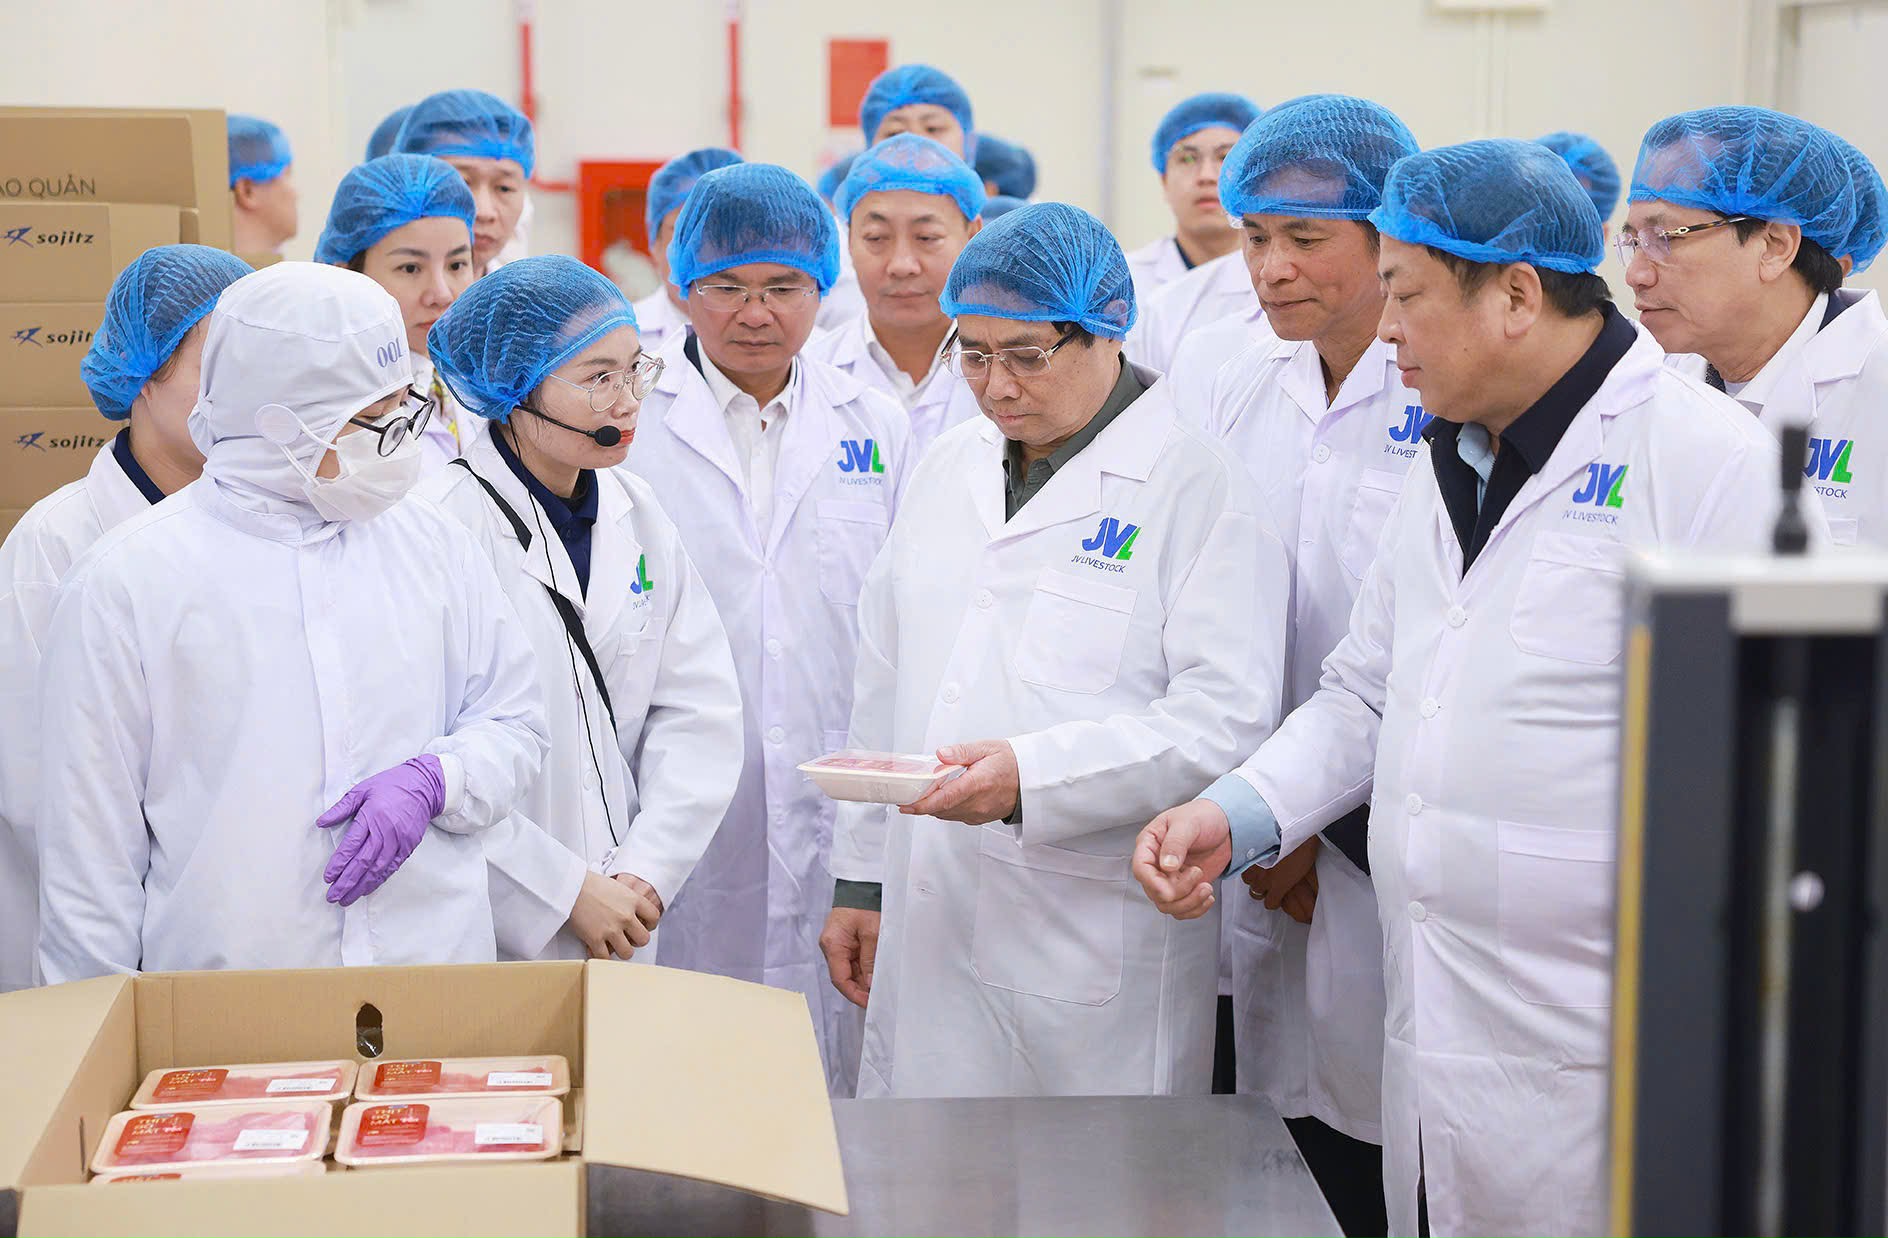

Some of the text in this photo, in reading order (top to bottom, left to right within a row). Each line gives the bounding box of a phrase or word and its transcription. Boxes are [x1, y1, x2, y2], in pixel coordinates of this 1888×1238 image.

[36, 231, 94, 246] sojitz
[46, 330, 94, 346] sojit
[377, 337, 404, 368] 001
[1388, 405, 1436, 444] JV
[49, 435, 105, 451] sojitz
[837, 439, 885, 474] JVL
[1391, 446, 1418, 459] LIVEST
[1802, 437, 1855, 484] JVL
[1572, 463, 1629, 509] JVL
[1081, 517, 1142, 561] JVL
[1080, 556, 1127, 573] LIVESTOCK
